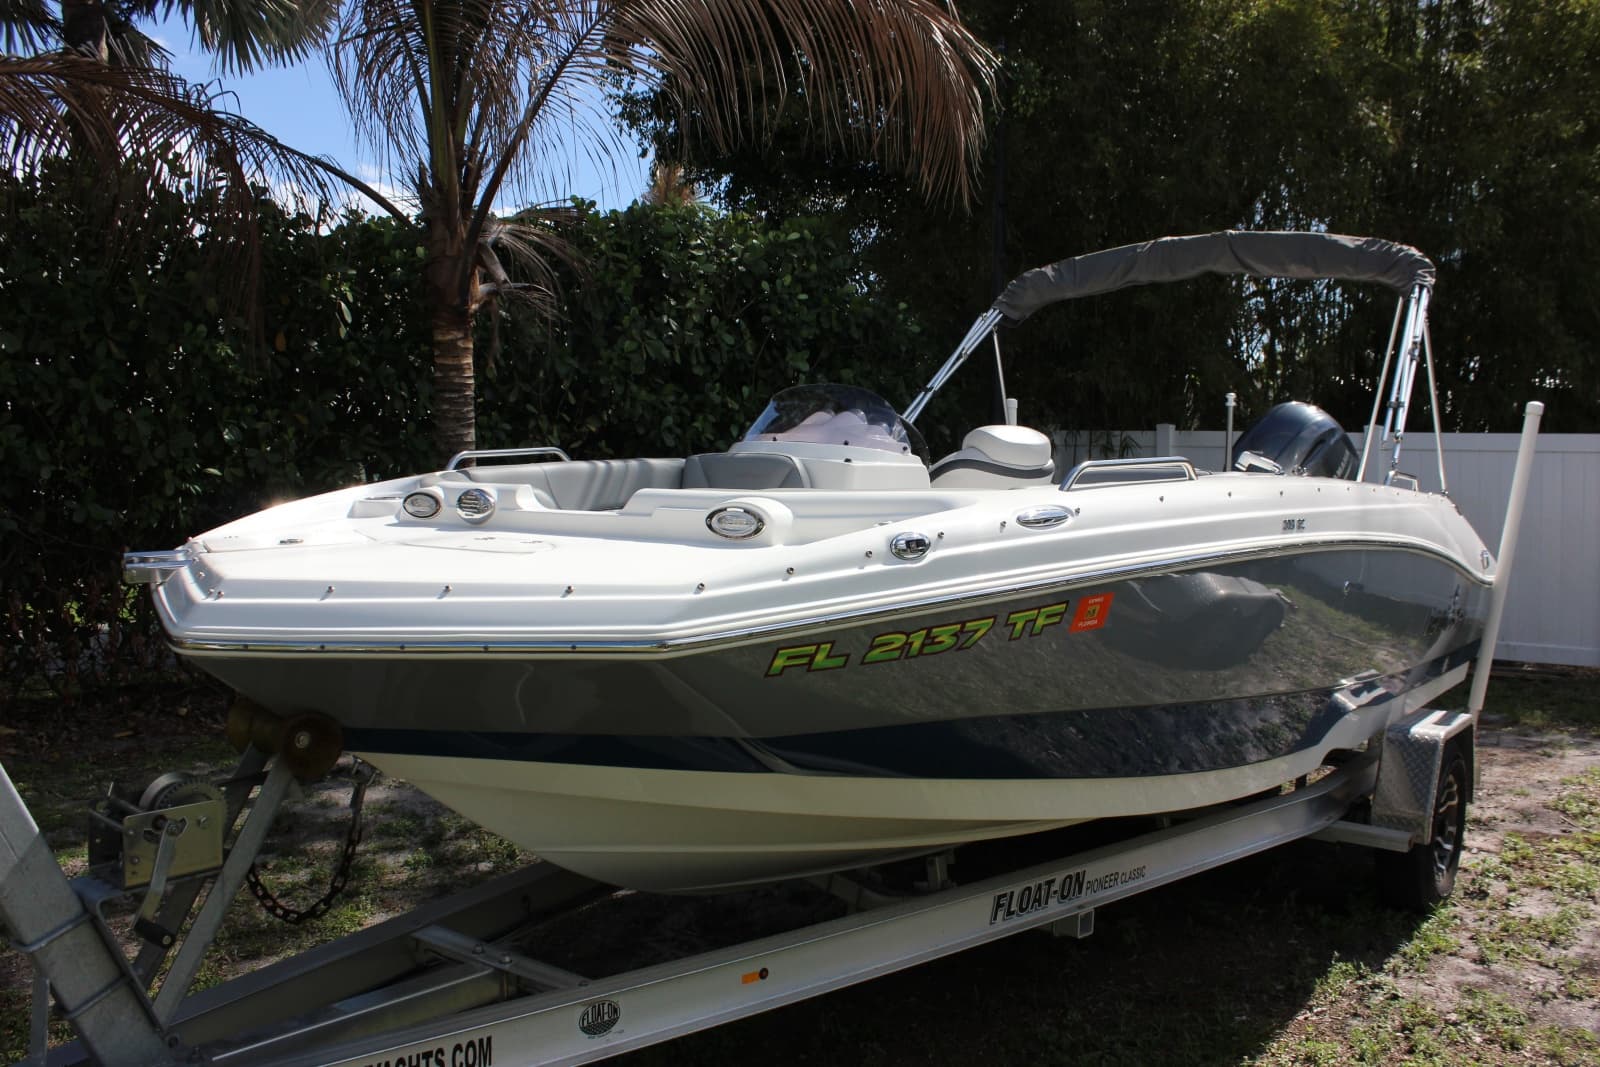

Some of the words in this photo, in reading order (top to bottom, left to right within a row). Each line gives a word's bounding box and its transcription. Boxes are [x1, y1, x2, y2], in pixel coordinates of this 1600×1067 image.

[764, 640, 850, 678] FL
[860, 614, 998, 665] 2137
[1004, 600, 1070, 641] TF
[988, 869, 1087, 925] FLOAT-ON
[1085, 871, 1120, 896] PIONEER
[1120, 865, 1147, 885] CLASSIC
[363, 1036, 493, 1067] TSCOM
